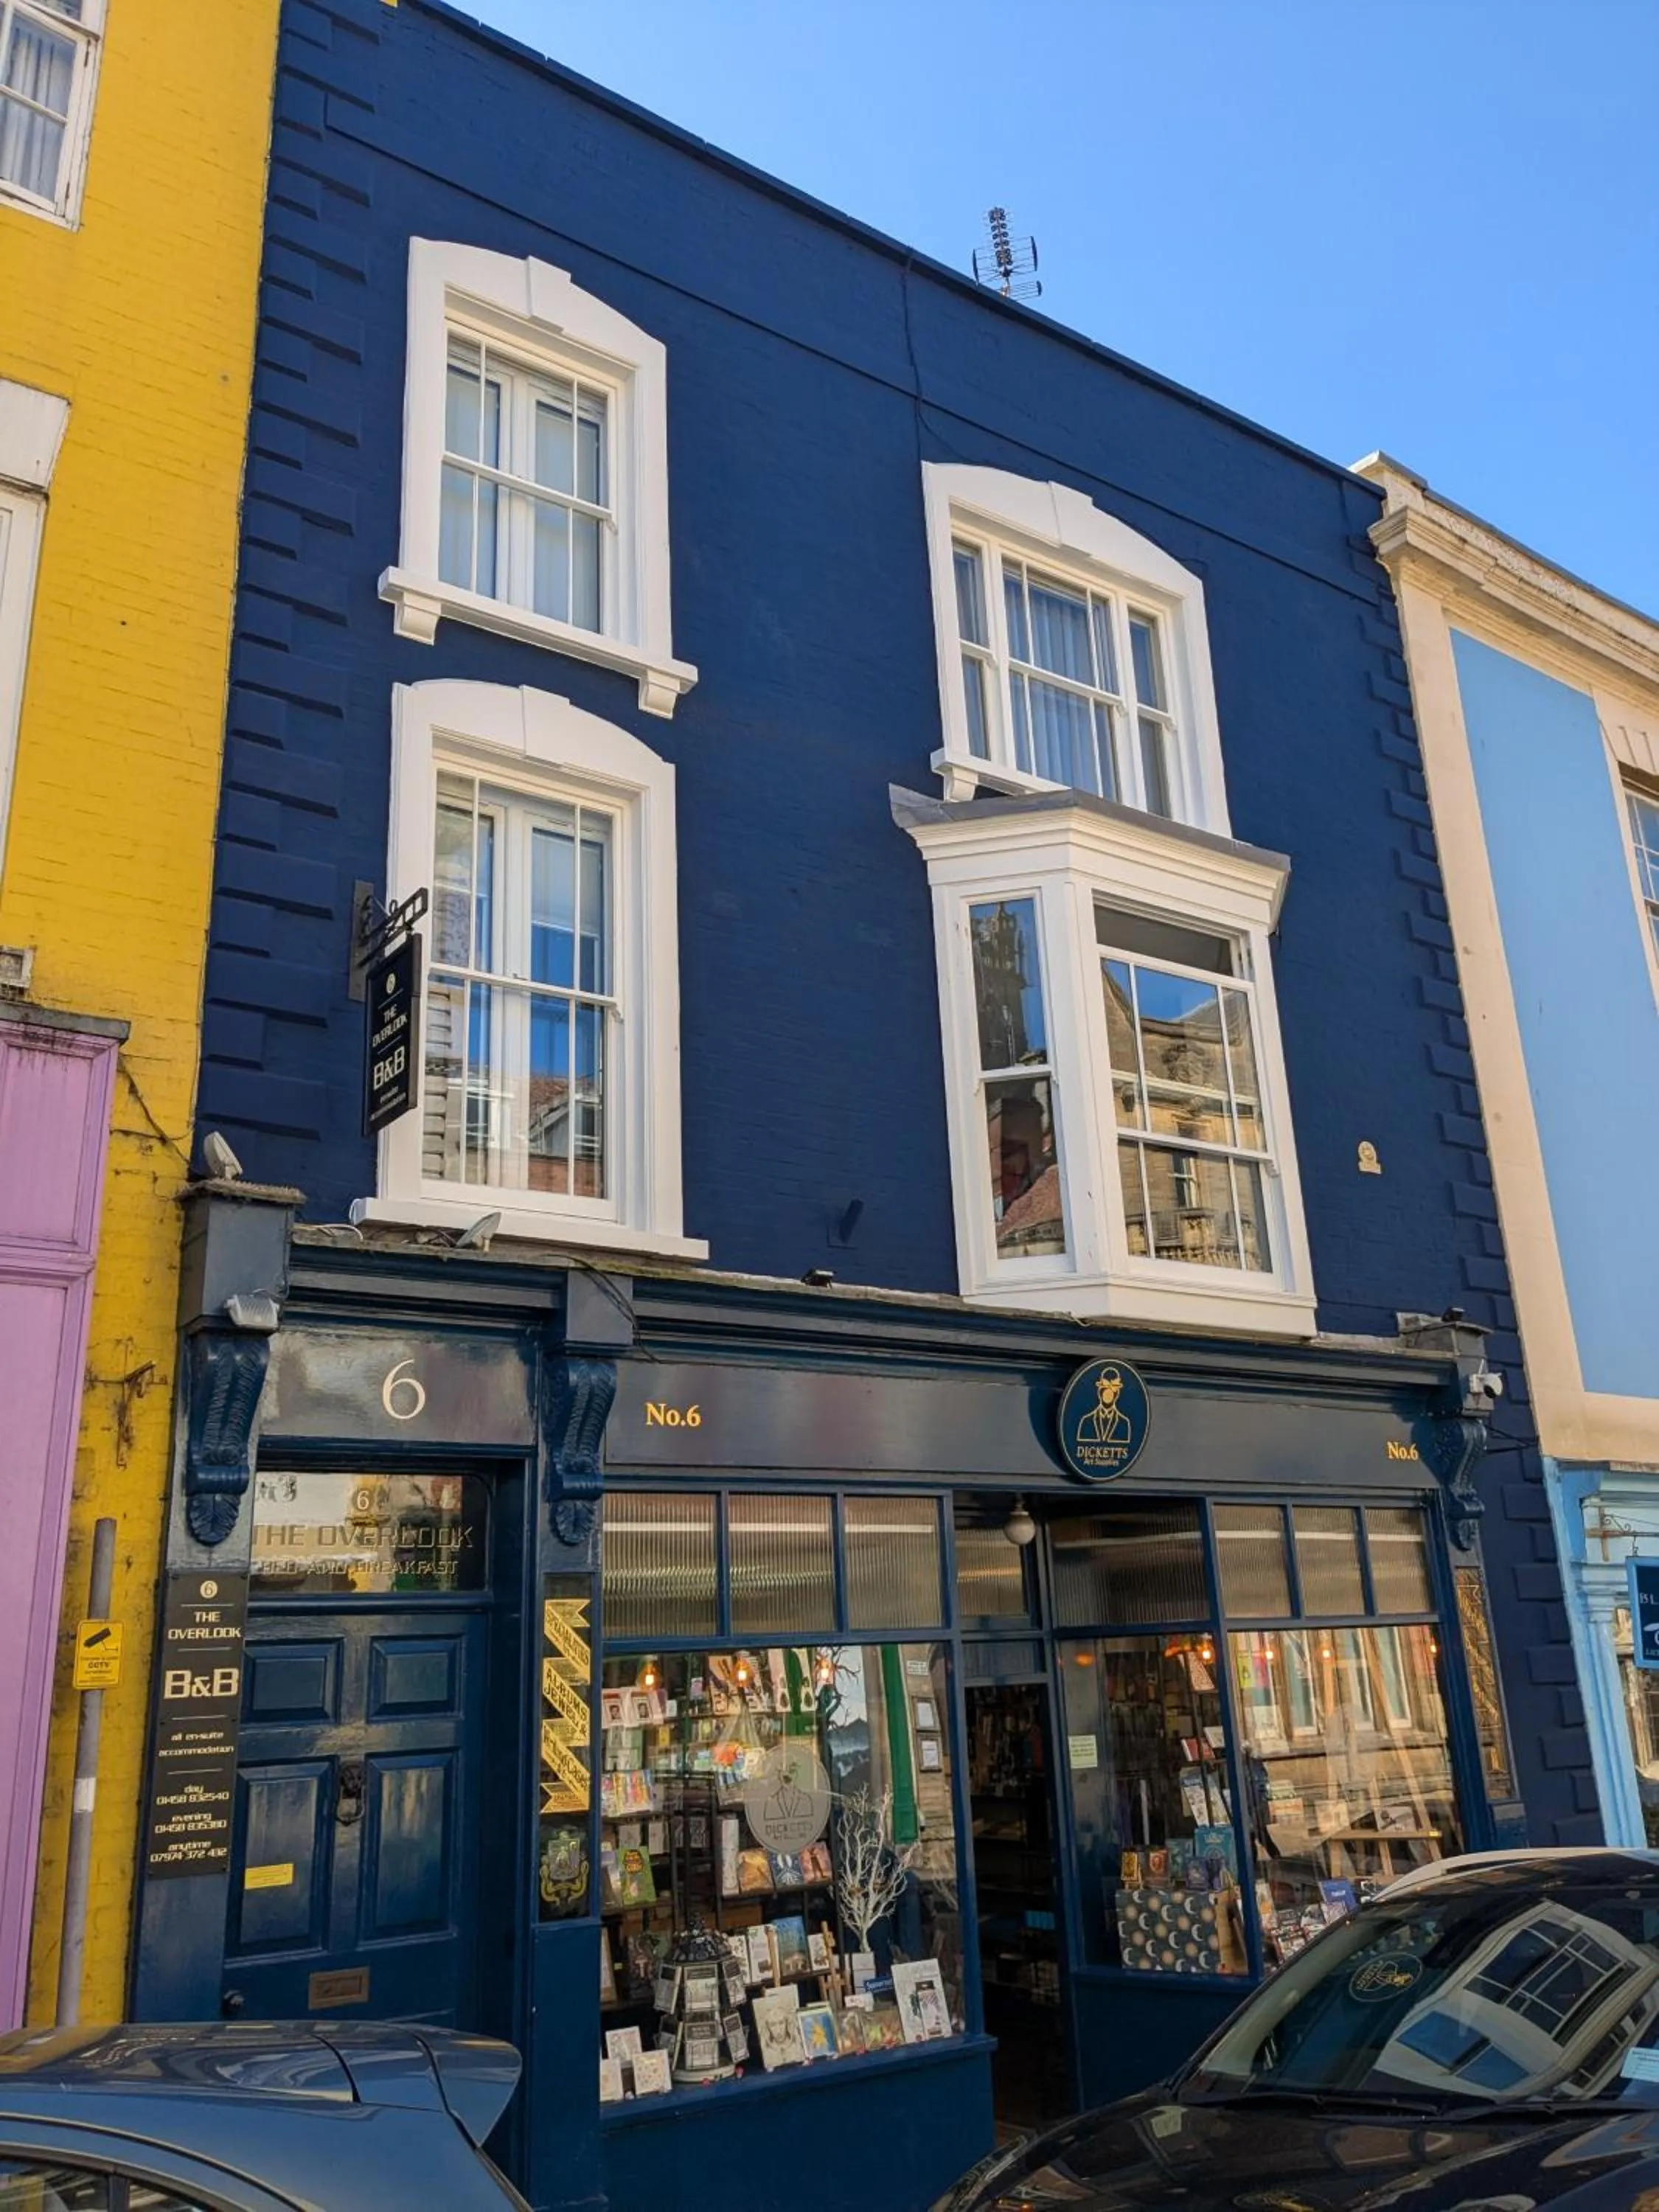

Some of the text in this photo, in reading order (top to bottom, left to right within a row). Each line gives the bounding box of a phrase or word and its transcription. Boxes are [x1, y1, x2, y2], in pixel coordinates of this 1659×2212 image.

[383, 1004, 397, 1023] THE
[372, 1012, 408, 1048] OVERLOOK
[373, 1046, 405, 1091] B&B
[383, 1359, 425, 1419] 6
[645, 1402, 701, 1427] No.6
[1077, 1446, 1129, 1459] DICKETTS
[1387, 1441, 1419, 1461] No.6
[355, 1490, 369, 1510] 6
[251, 1524, 473, 1548] THE OVERLOOK
[356, 1559, 459, 1575] BREAKFAST
[193, 1611, 221, 1623] THE
[168, 1627, 243, 1640] OVERLOOK
[164, 1668, 240, 1700] B&B
[171, 1732, 183, 1742] all
[159, 1745, 234, 1757] accommodation
[184, 1784, 204, 1794] day
[156, 1791, 230, 1805] 01458 832540
[172, 1812, 212, 1822] evening
[167, 1840, 211, 1851] anytime
[185, 1849, 206, 1859] 372
